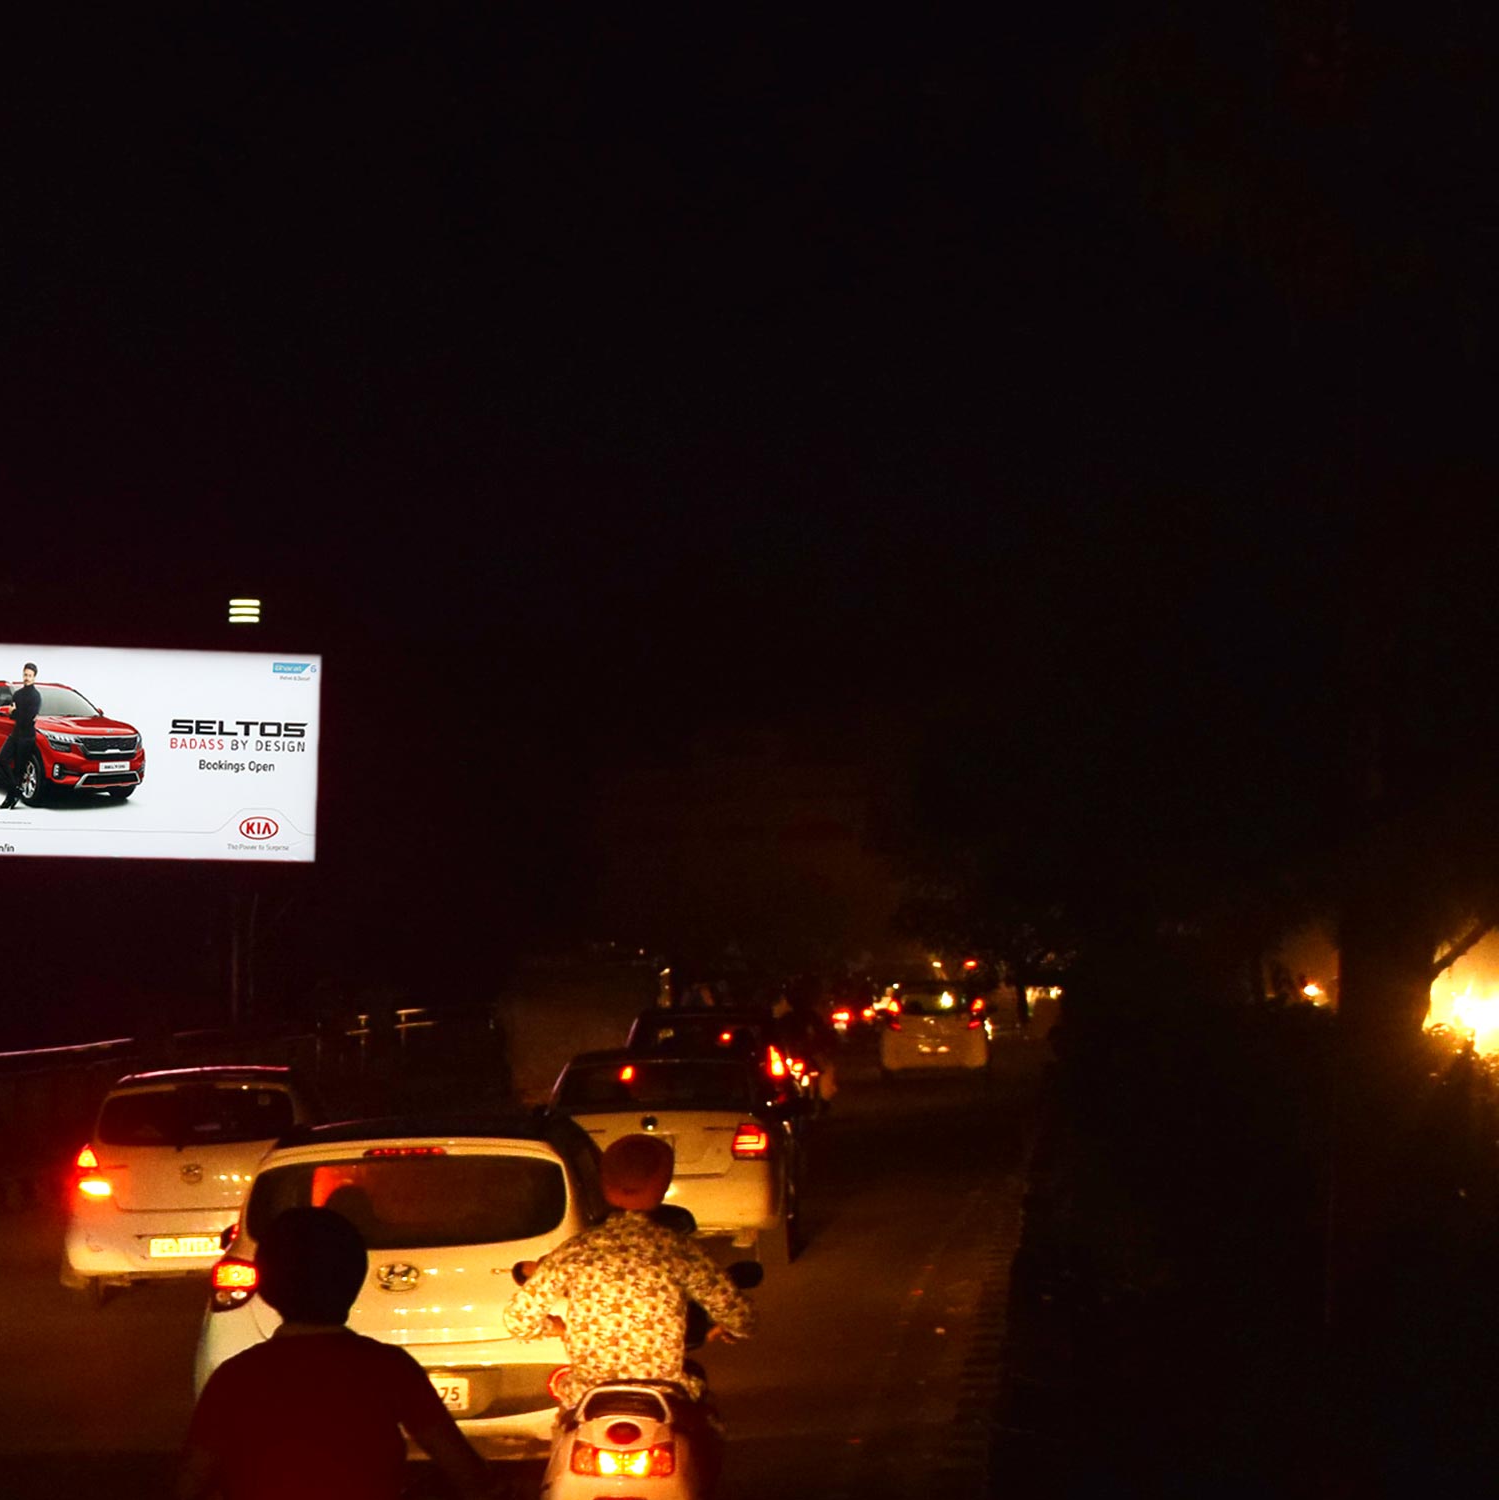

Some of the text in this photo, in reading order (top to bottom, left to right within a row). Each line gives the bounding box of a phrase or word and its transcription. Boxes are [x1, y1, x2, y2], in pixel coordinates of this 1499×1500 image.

[169, 719, 308, 738] SELTOS
[169, 737, 306, 752] BADASS BY DESIGN
[199, 759, 275, 774] Bookings Open
[246, 822, 272, 835] KIA
